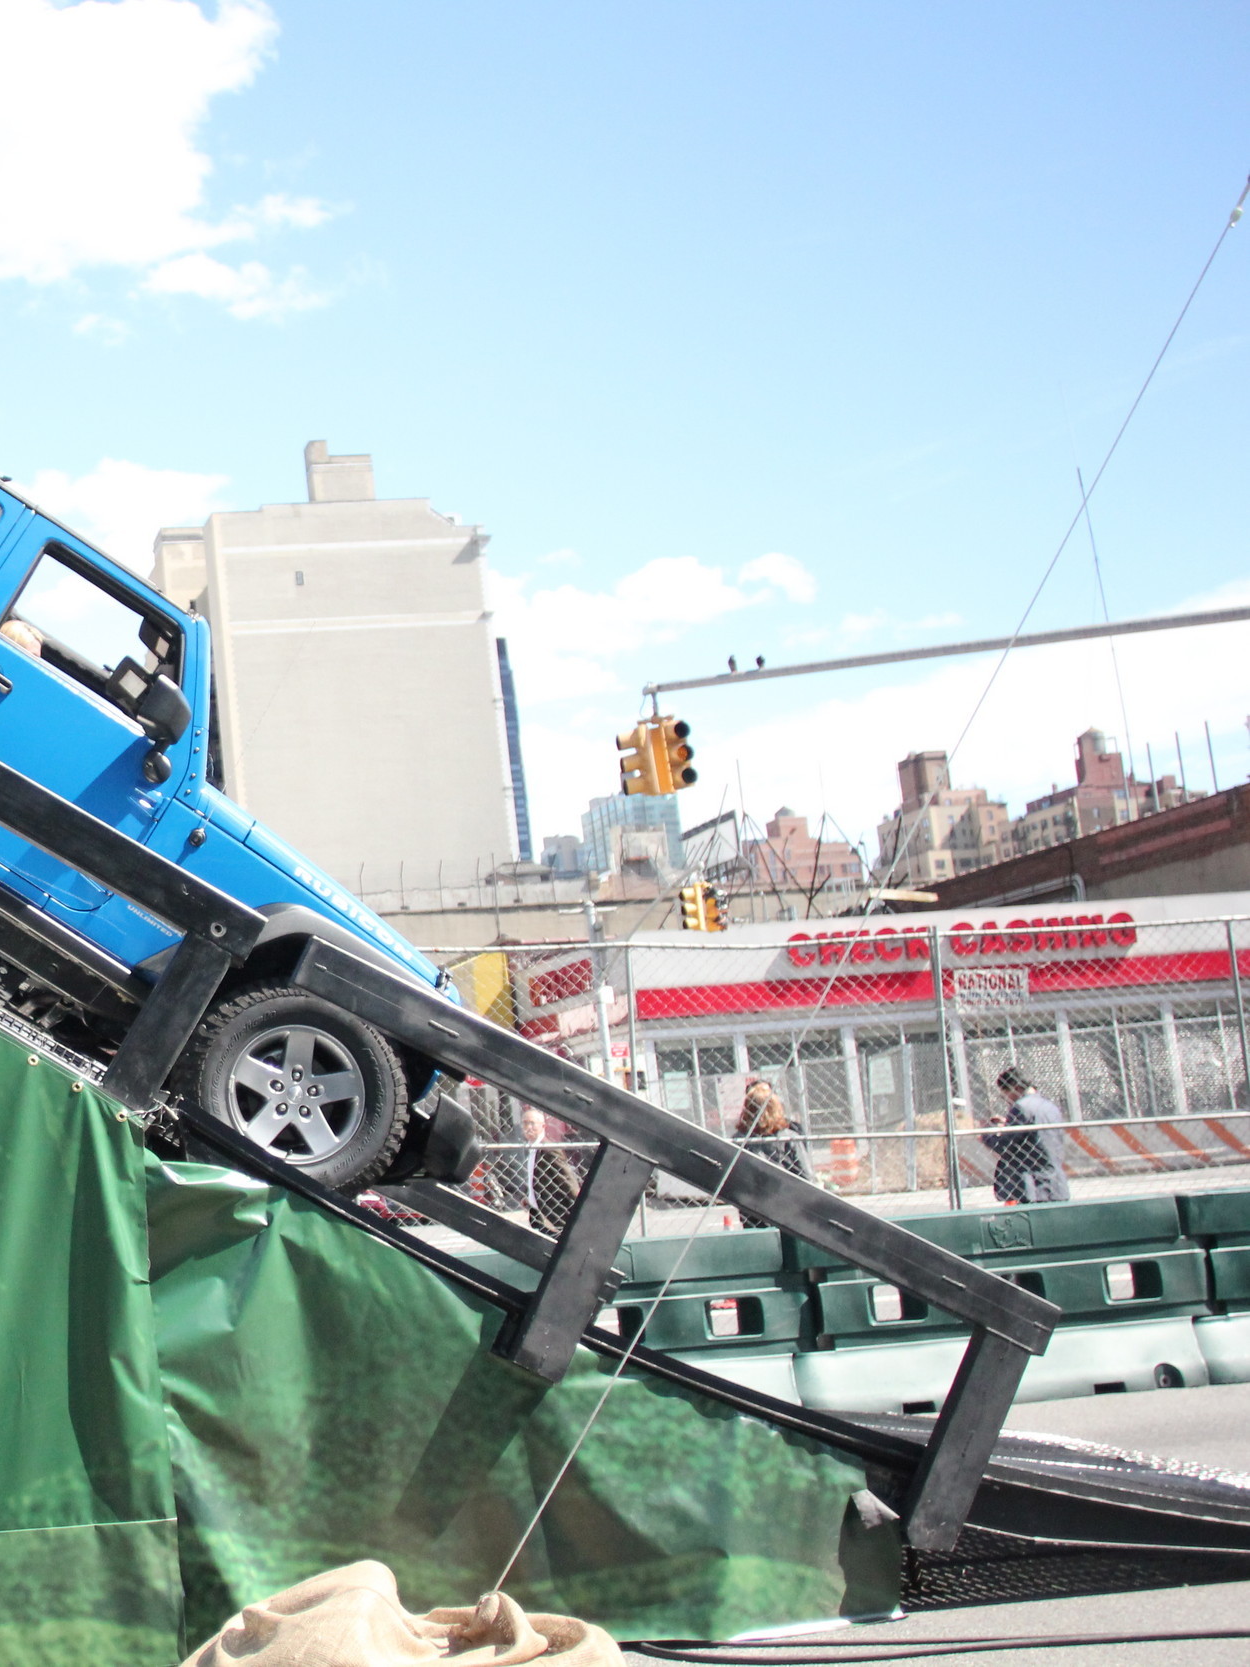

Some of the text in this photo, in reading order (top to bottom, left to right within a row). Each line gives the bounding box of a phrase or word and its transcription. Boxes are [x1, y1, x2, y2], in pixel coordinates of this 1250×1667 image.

[127, 904, 172, 937] UNLIMITED
[294, 865, 413, 961] RUBICON
[787, 911, 1136, 967] CHECK CASHING
[958, 973, 1024, 990] NATIONAL
